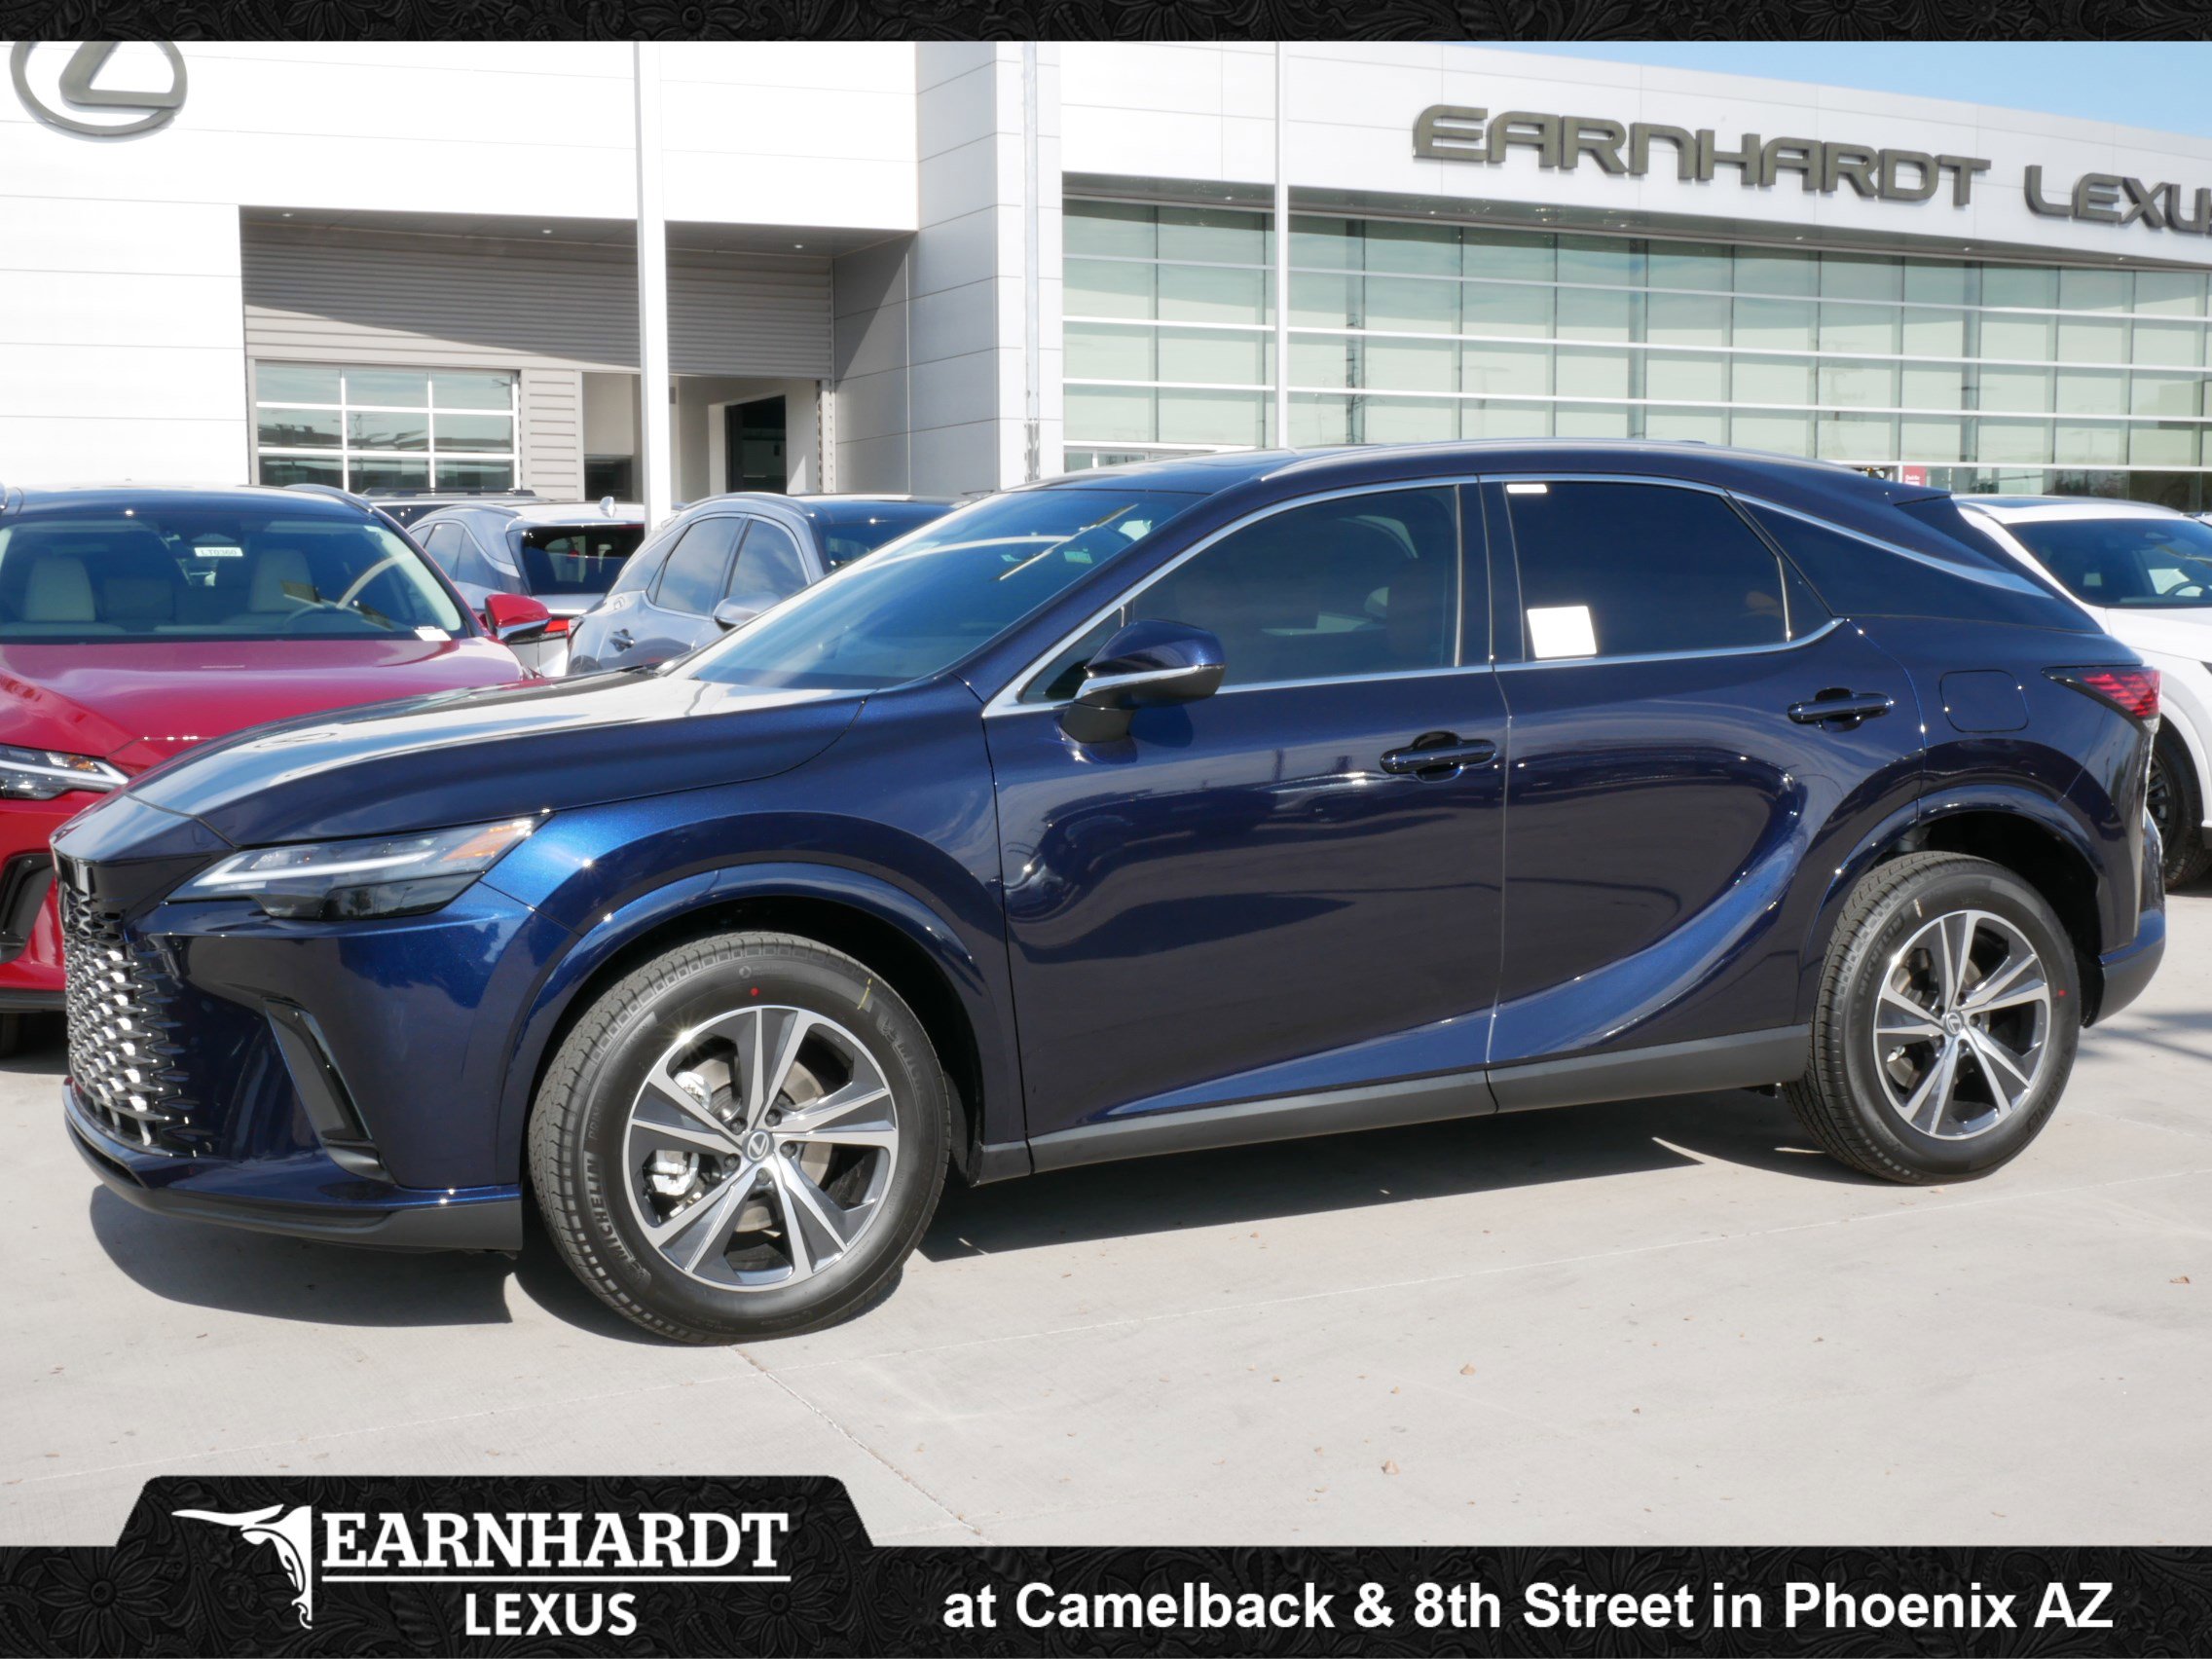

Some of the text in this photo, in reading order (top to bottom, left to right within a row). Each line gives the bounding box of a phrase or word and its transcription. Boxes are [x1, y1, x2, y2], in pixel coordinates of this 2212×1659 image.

[1413, 104, 2212, 236] EARNHARDT LEXU
[587, 1152, 629, 1261] MICHELIN
